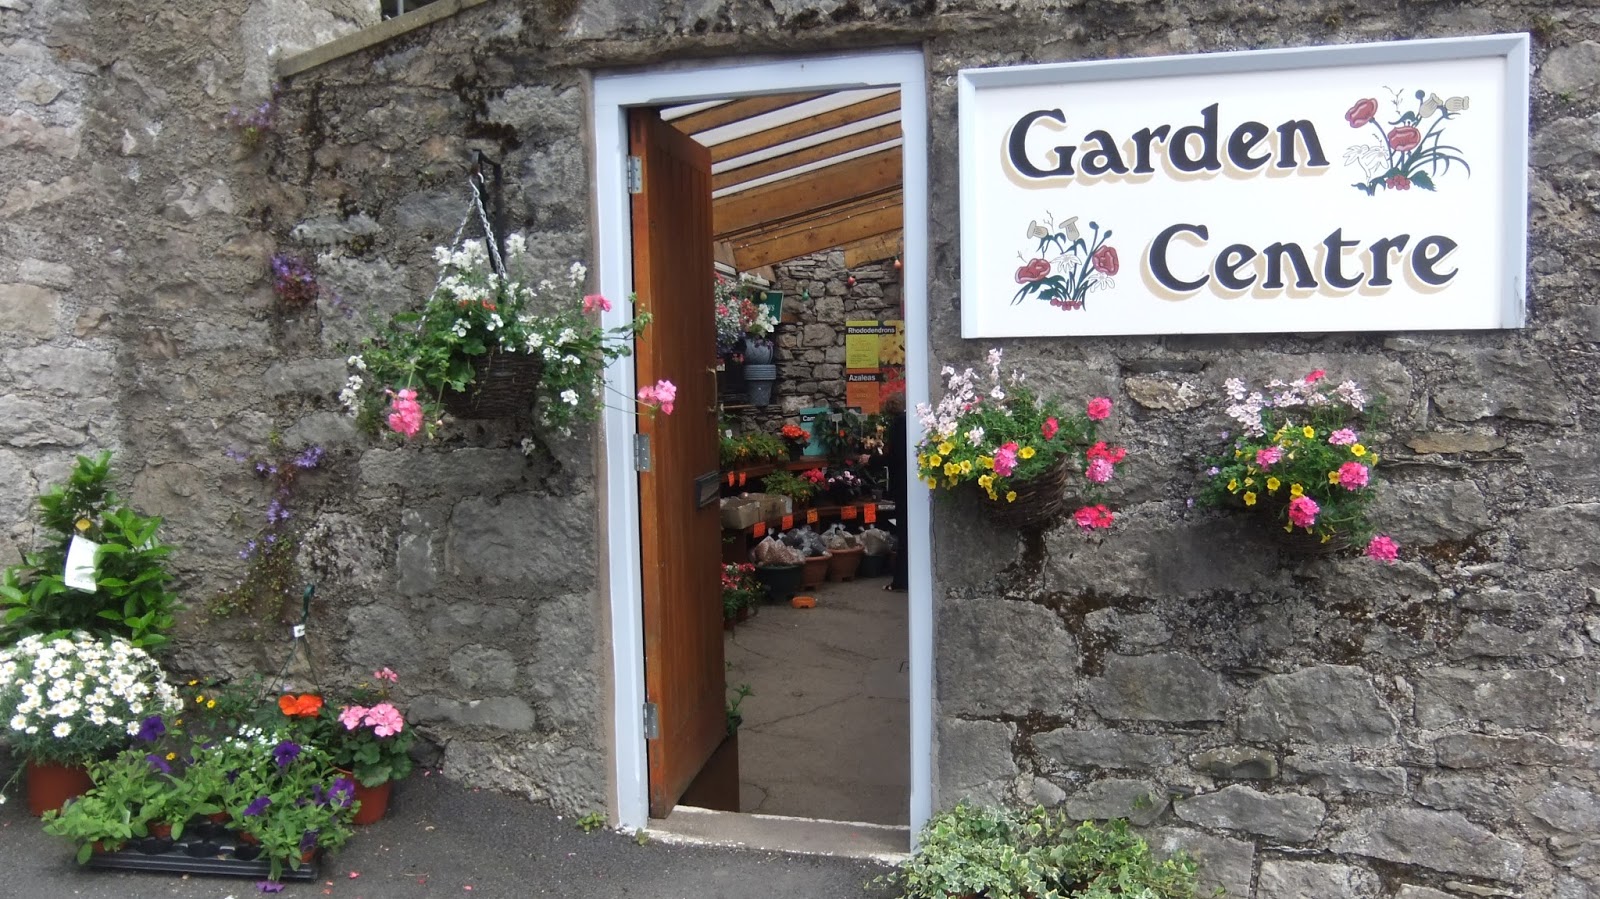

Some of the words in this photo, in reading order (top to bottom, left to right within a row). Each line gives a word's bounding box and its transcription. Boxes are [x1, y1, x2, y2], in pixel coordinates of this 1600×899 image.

[1006, 102, 1331, 180] Garden
[1146, 222, 1459, 293] Centre
[847, 327, 896, 335] Rhododendrons
[848, 373, 877, 382] Azaleas
